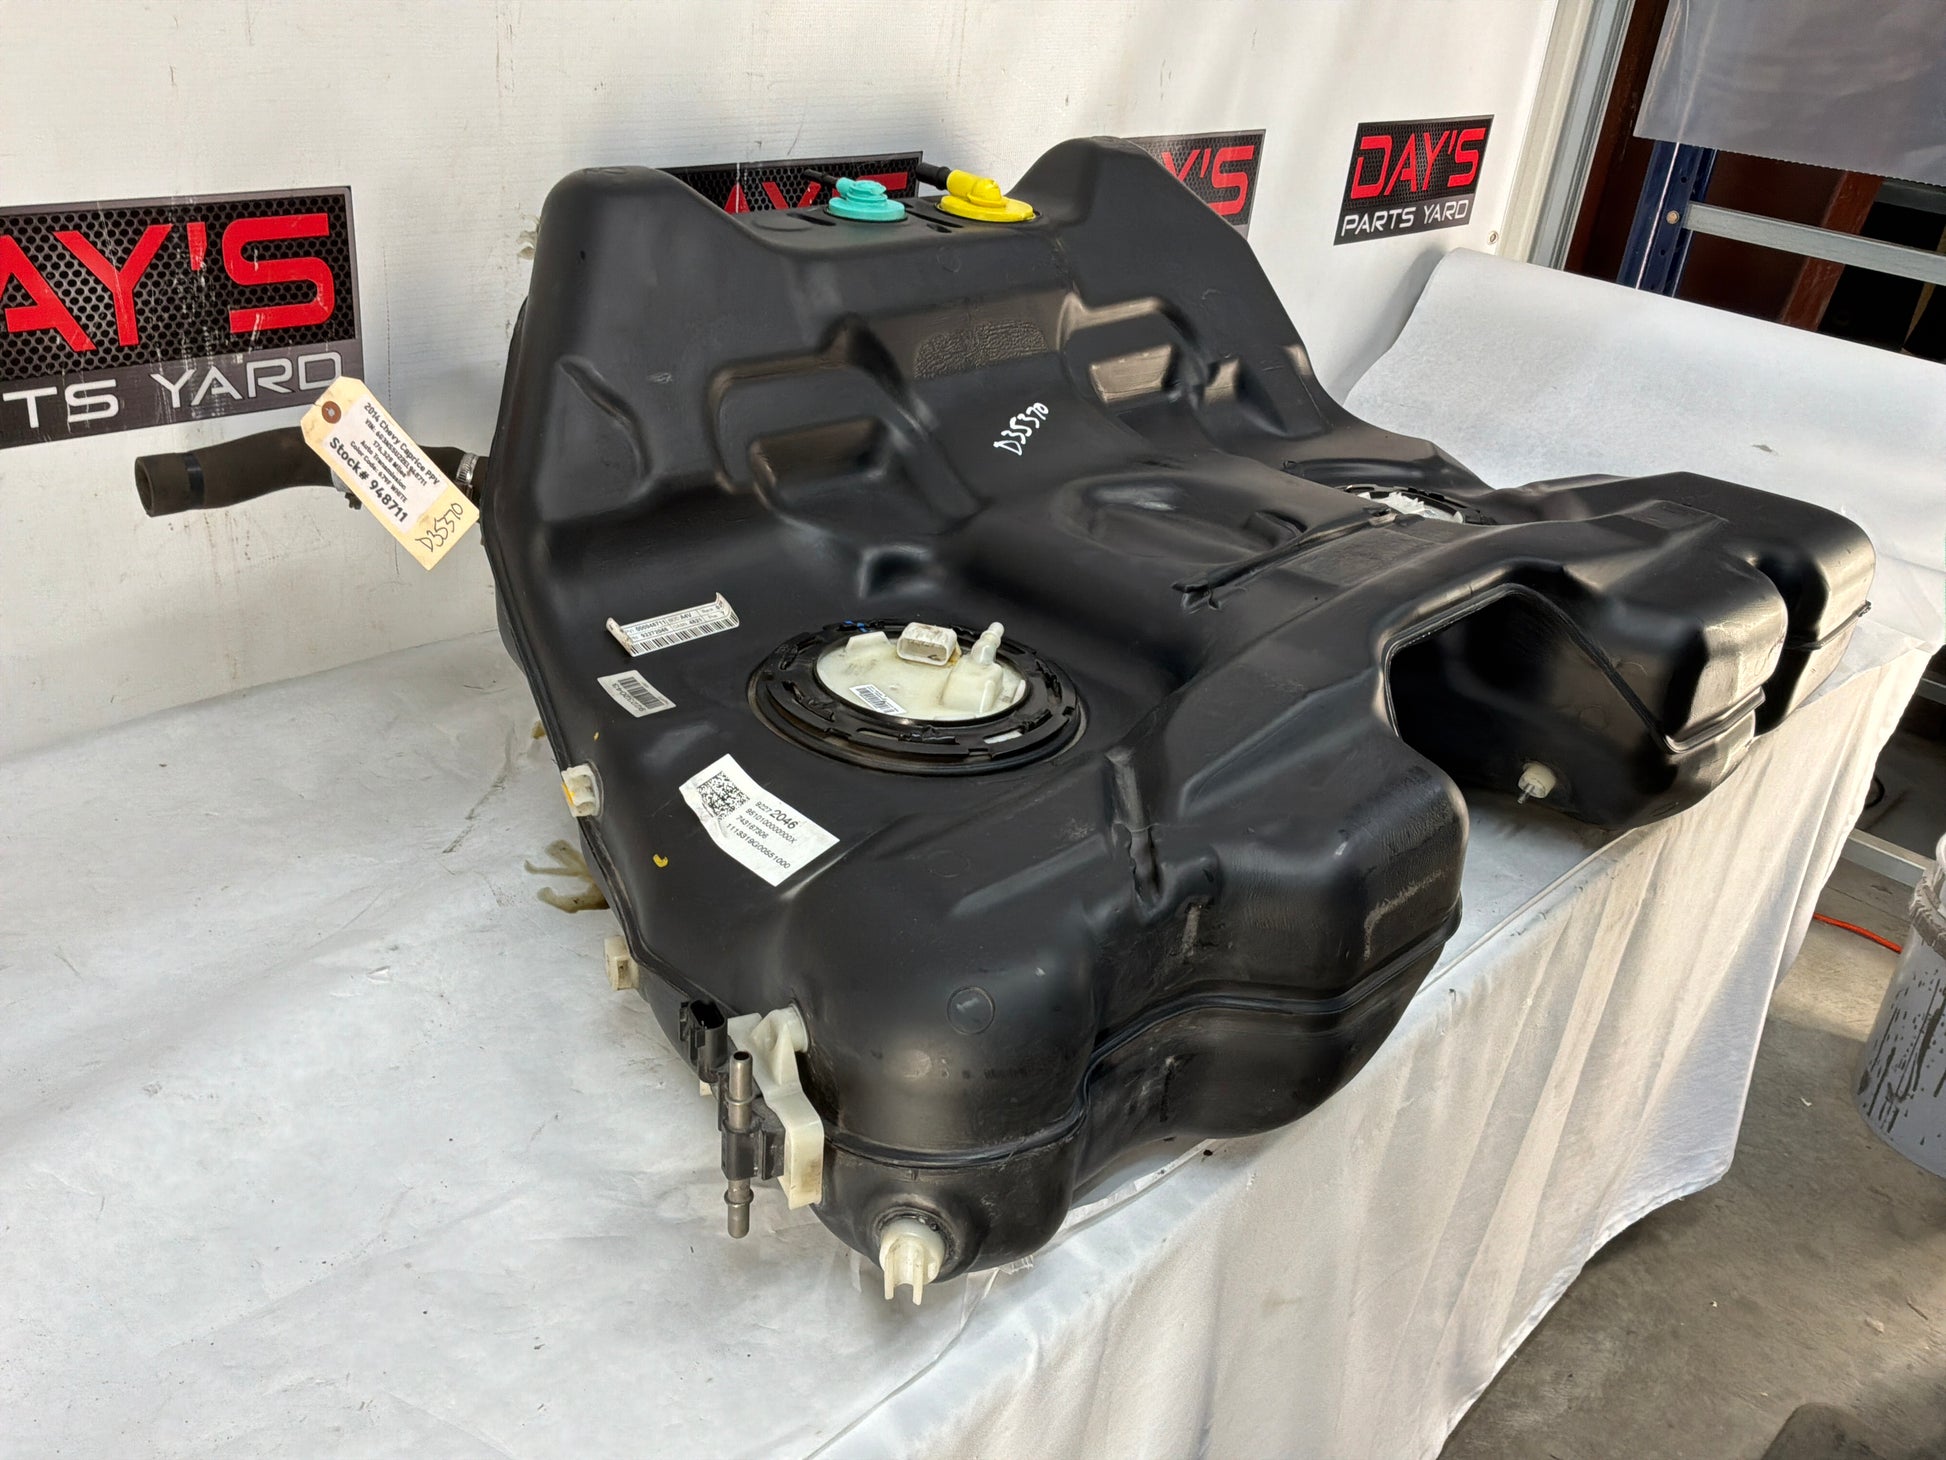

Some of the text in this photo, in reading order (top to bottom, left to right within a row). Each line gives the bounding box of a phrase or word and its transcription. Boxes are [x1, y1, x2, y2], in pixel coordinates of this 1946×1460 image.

[1351, 127, 1487, 200] DAY'S
[1341, 199, 1470, 237] PARTS YARD
[0, 212, 336, 352] AY'S
[150, 351, 342, 409] YARD
[350, 441, 365, 458] Color
[363, 456, 379, 474] Code:
[390, 484, 408, 504] WHITE
[360, 439, 407, 491] Auto Transmission
[364, 402, 440, 486] 2014 Chevy Caprice PPV
[392, 461, 407, 479] Miles
[329, 436, 409, 523] Stock# 948711
[769, 808, 799, 831] 2046
